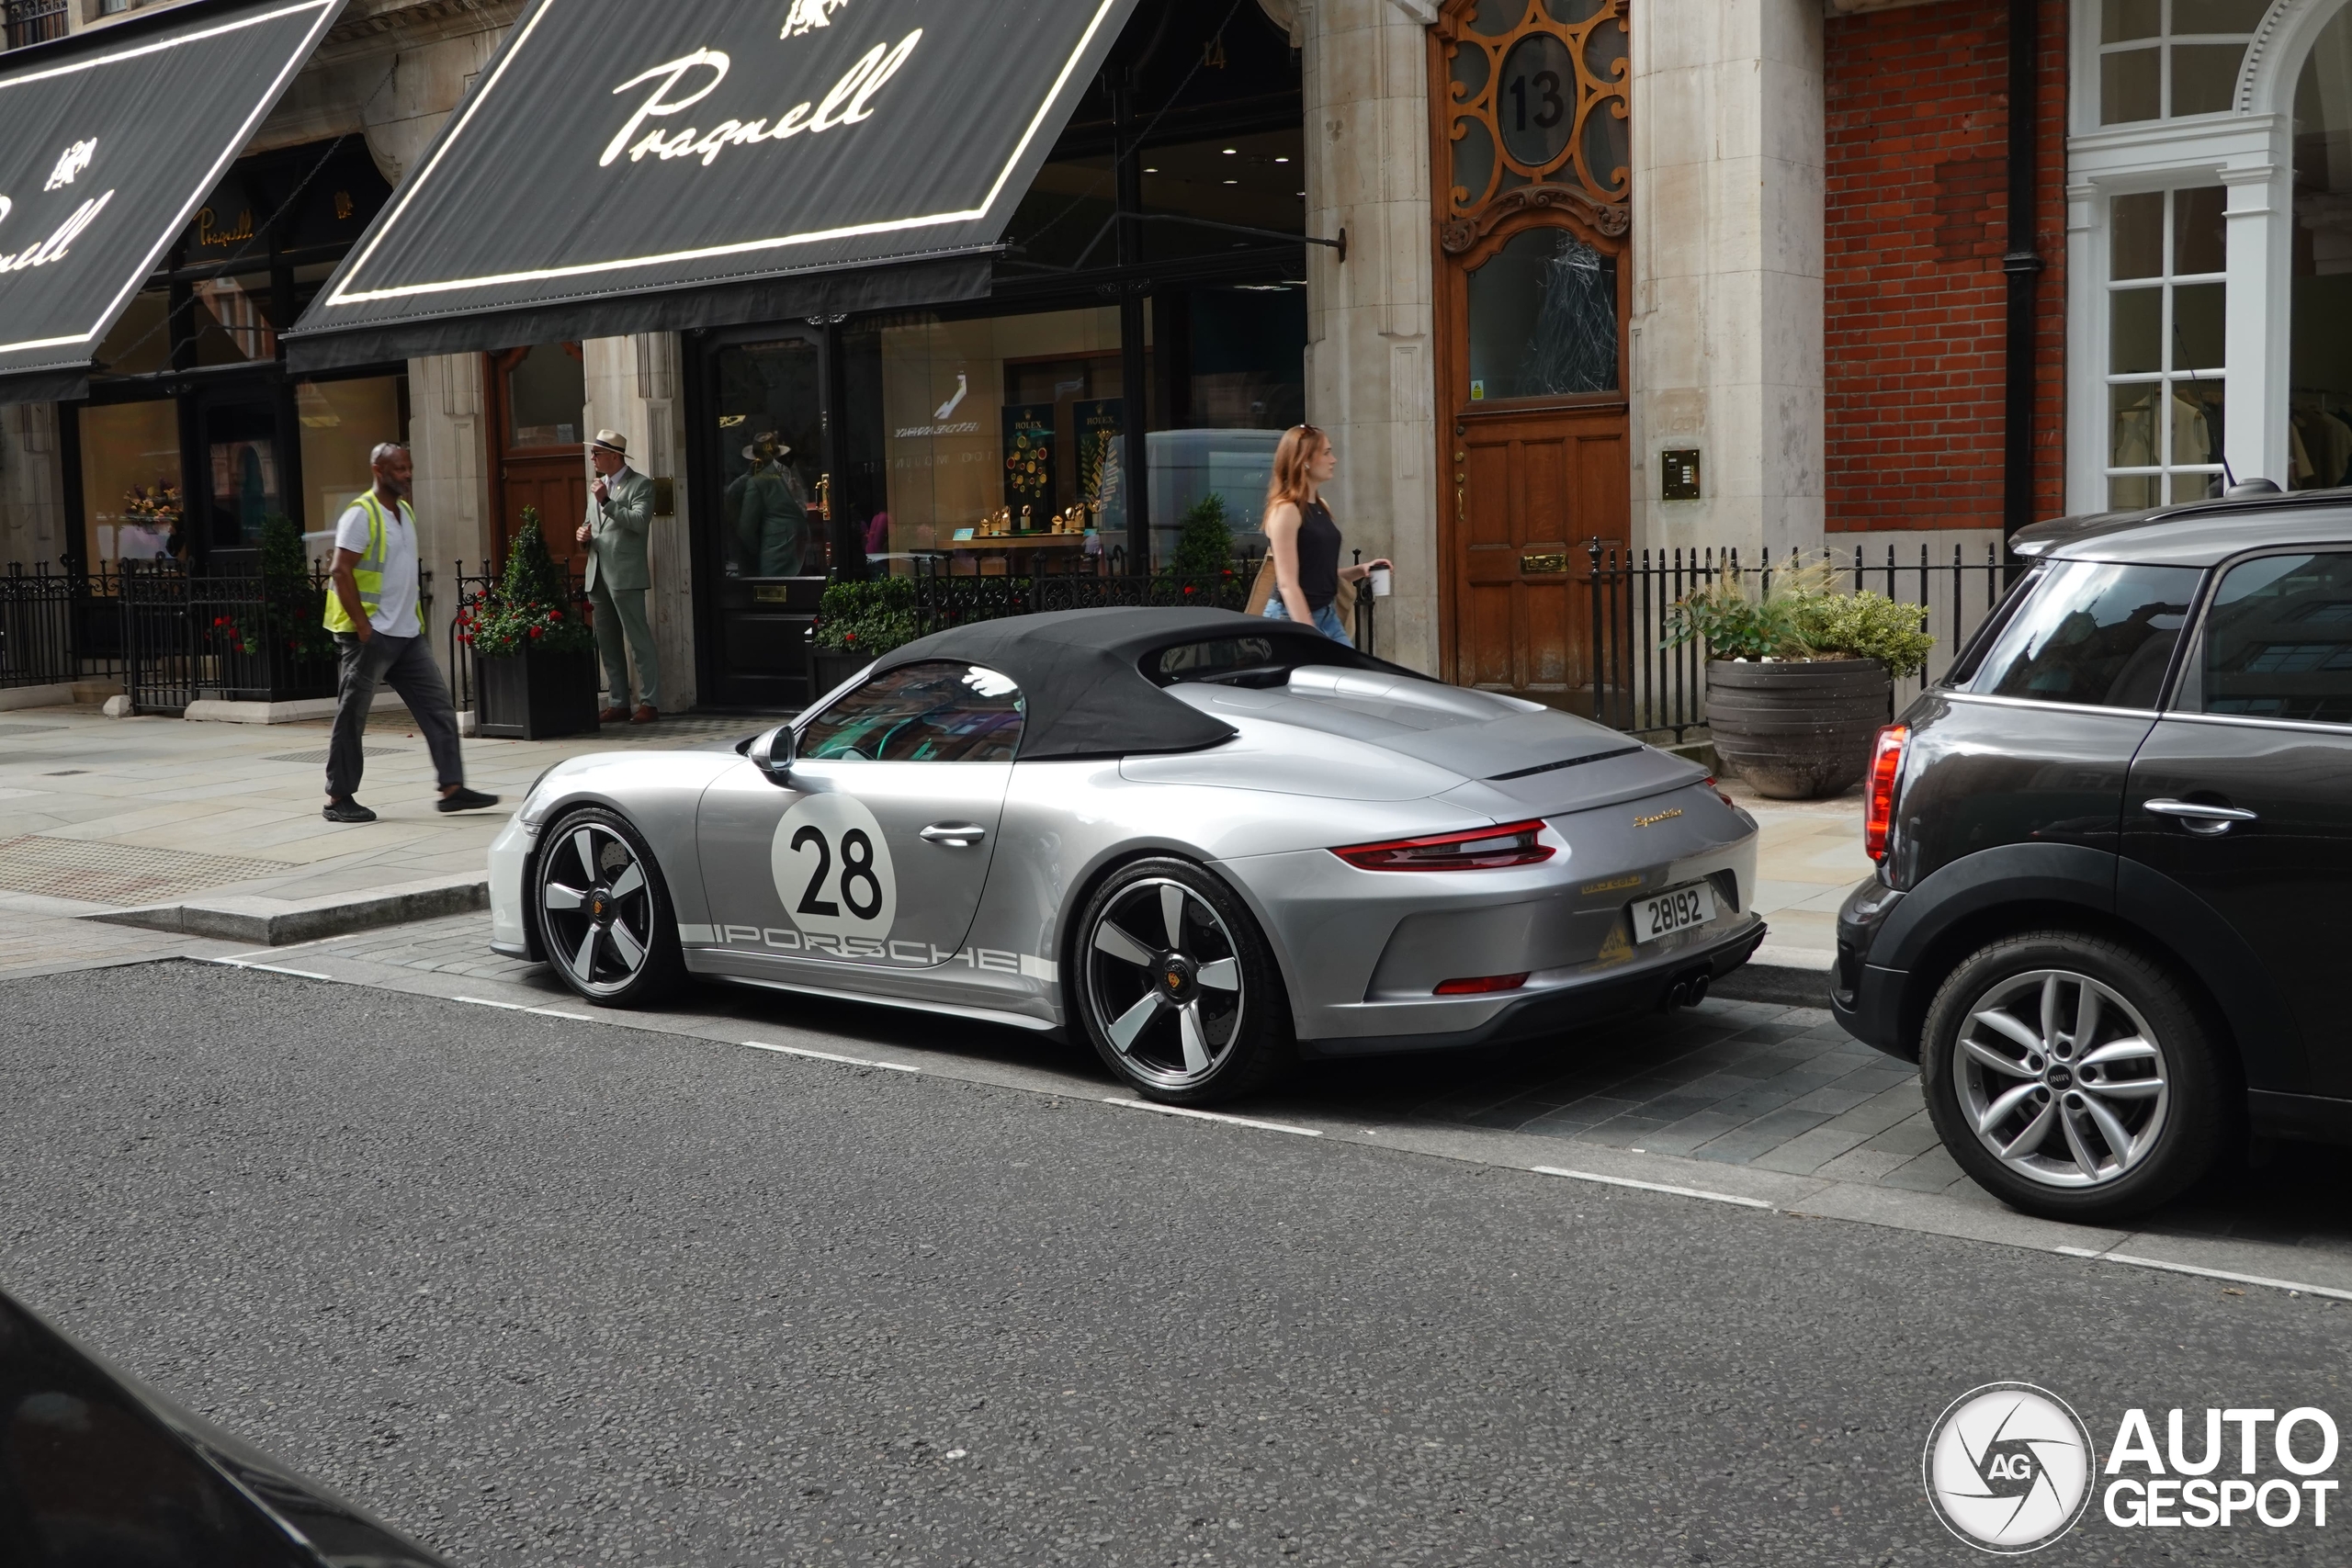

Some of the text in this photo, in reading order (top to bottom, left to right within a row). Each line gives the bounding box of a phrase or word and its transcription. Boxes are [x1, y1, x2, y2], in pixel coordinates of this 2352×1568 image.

[600, 28, 923, 167] Pragnell
[1510, 70, 1564, 131] 13
[193, 207, 254, 247] Pragnell
[1014, 421, 1042, 430] ROLEX
[1087, 416, 1114, 425] ROLEX
[790, 825, 883, 920] 28
[1648, 889, 1702, 935] 28192
[723, 924, 1019, 975] PORSCHE
[2050, 1073, 2070, 1083] MINI
